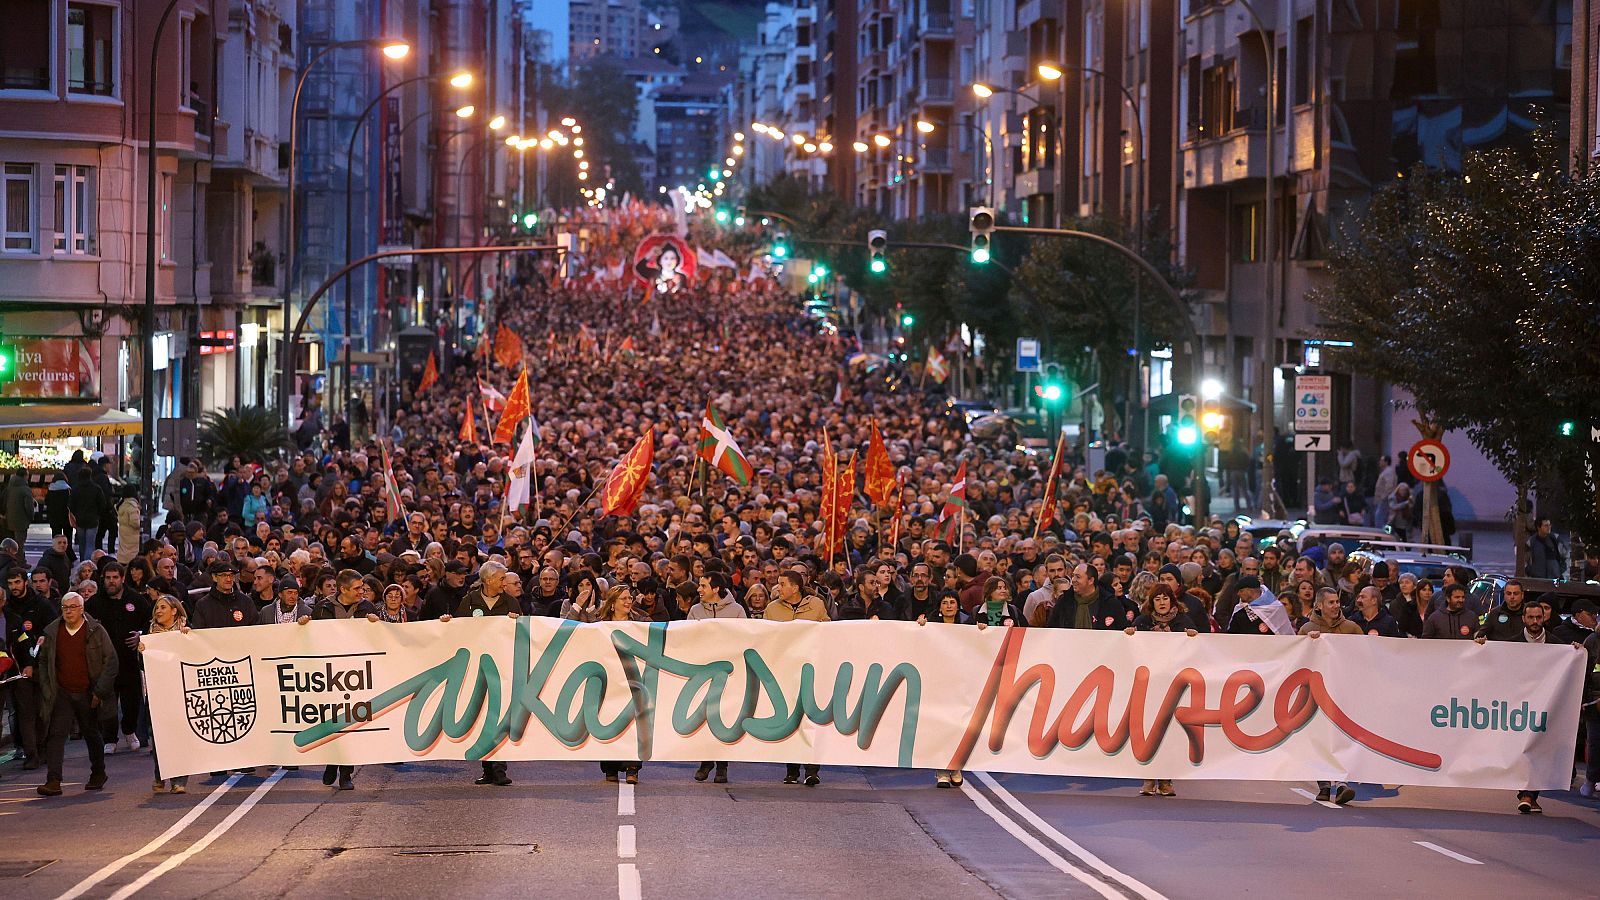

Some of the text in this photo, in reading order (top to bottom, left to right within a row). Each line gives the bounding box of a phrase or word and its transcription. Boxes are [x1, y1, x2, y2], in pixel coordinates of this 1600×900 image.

[17, 368, 76, 382] verduras
[10, 429, 35, 440] abierto
[57, 427, 72, 439] 365
[97, 426, 109, 436] del
[197, 665, 239, 678] EUSKAL
[197, 675, 239, 687] HERRIA
[276, 660, 373, 693] Euskal
[294, 615, 922, 768] askatasun
[281, 694, 373, 725] Herria
[1430, 697, 1548, 733] ehbildu
